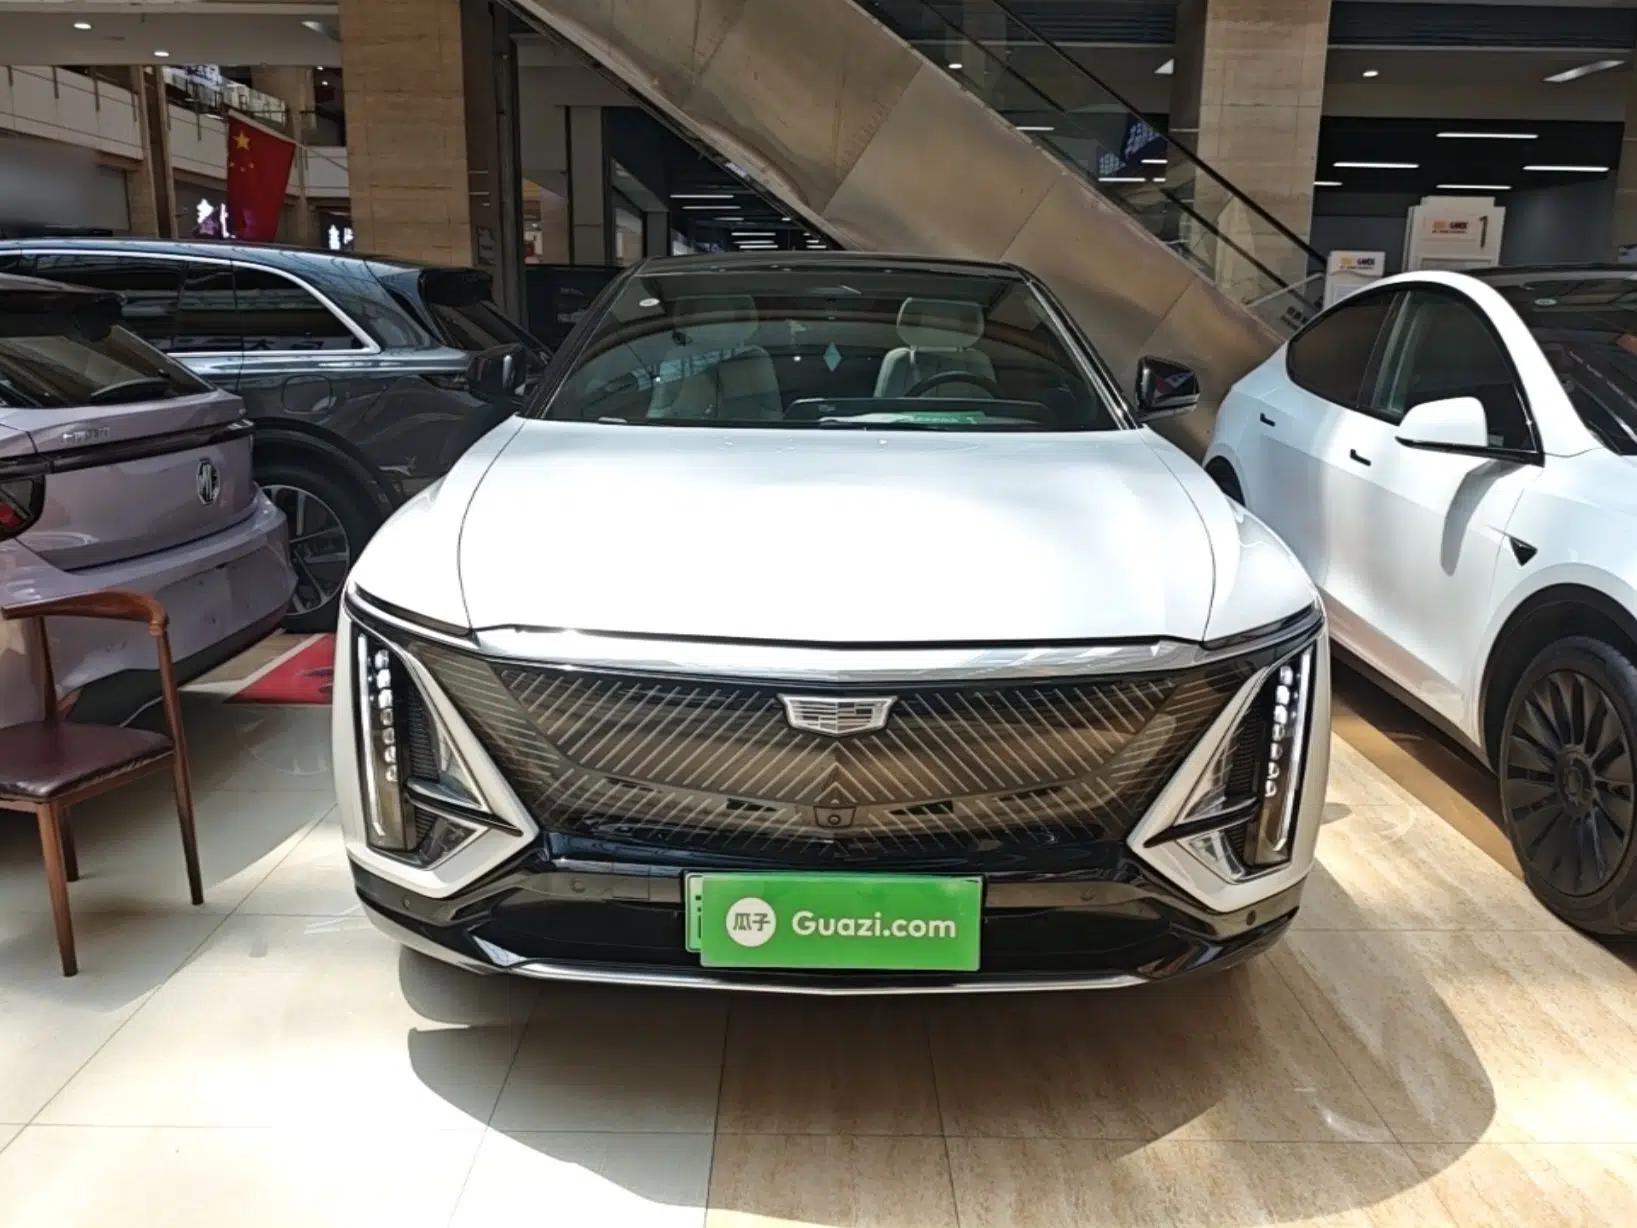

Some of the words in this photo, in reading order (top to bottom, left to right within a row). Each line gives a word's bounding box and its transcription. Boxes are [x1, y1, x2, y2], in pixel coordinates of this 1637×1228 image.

[1479, 215, 1489, 248] 1
[198, 462, 219, 502] MG
[732, 912, 771, 932] 瓜子
[791, 910, 957, 938] Guazi.com
